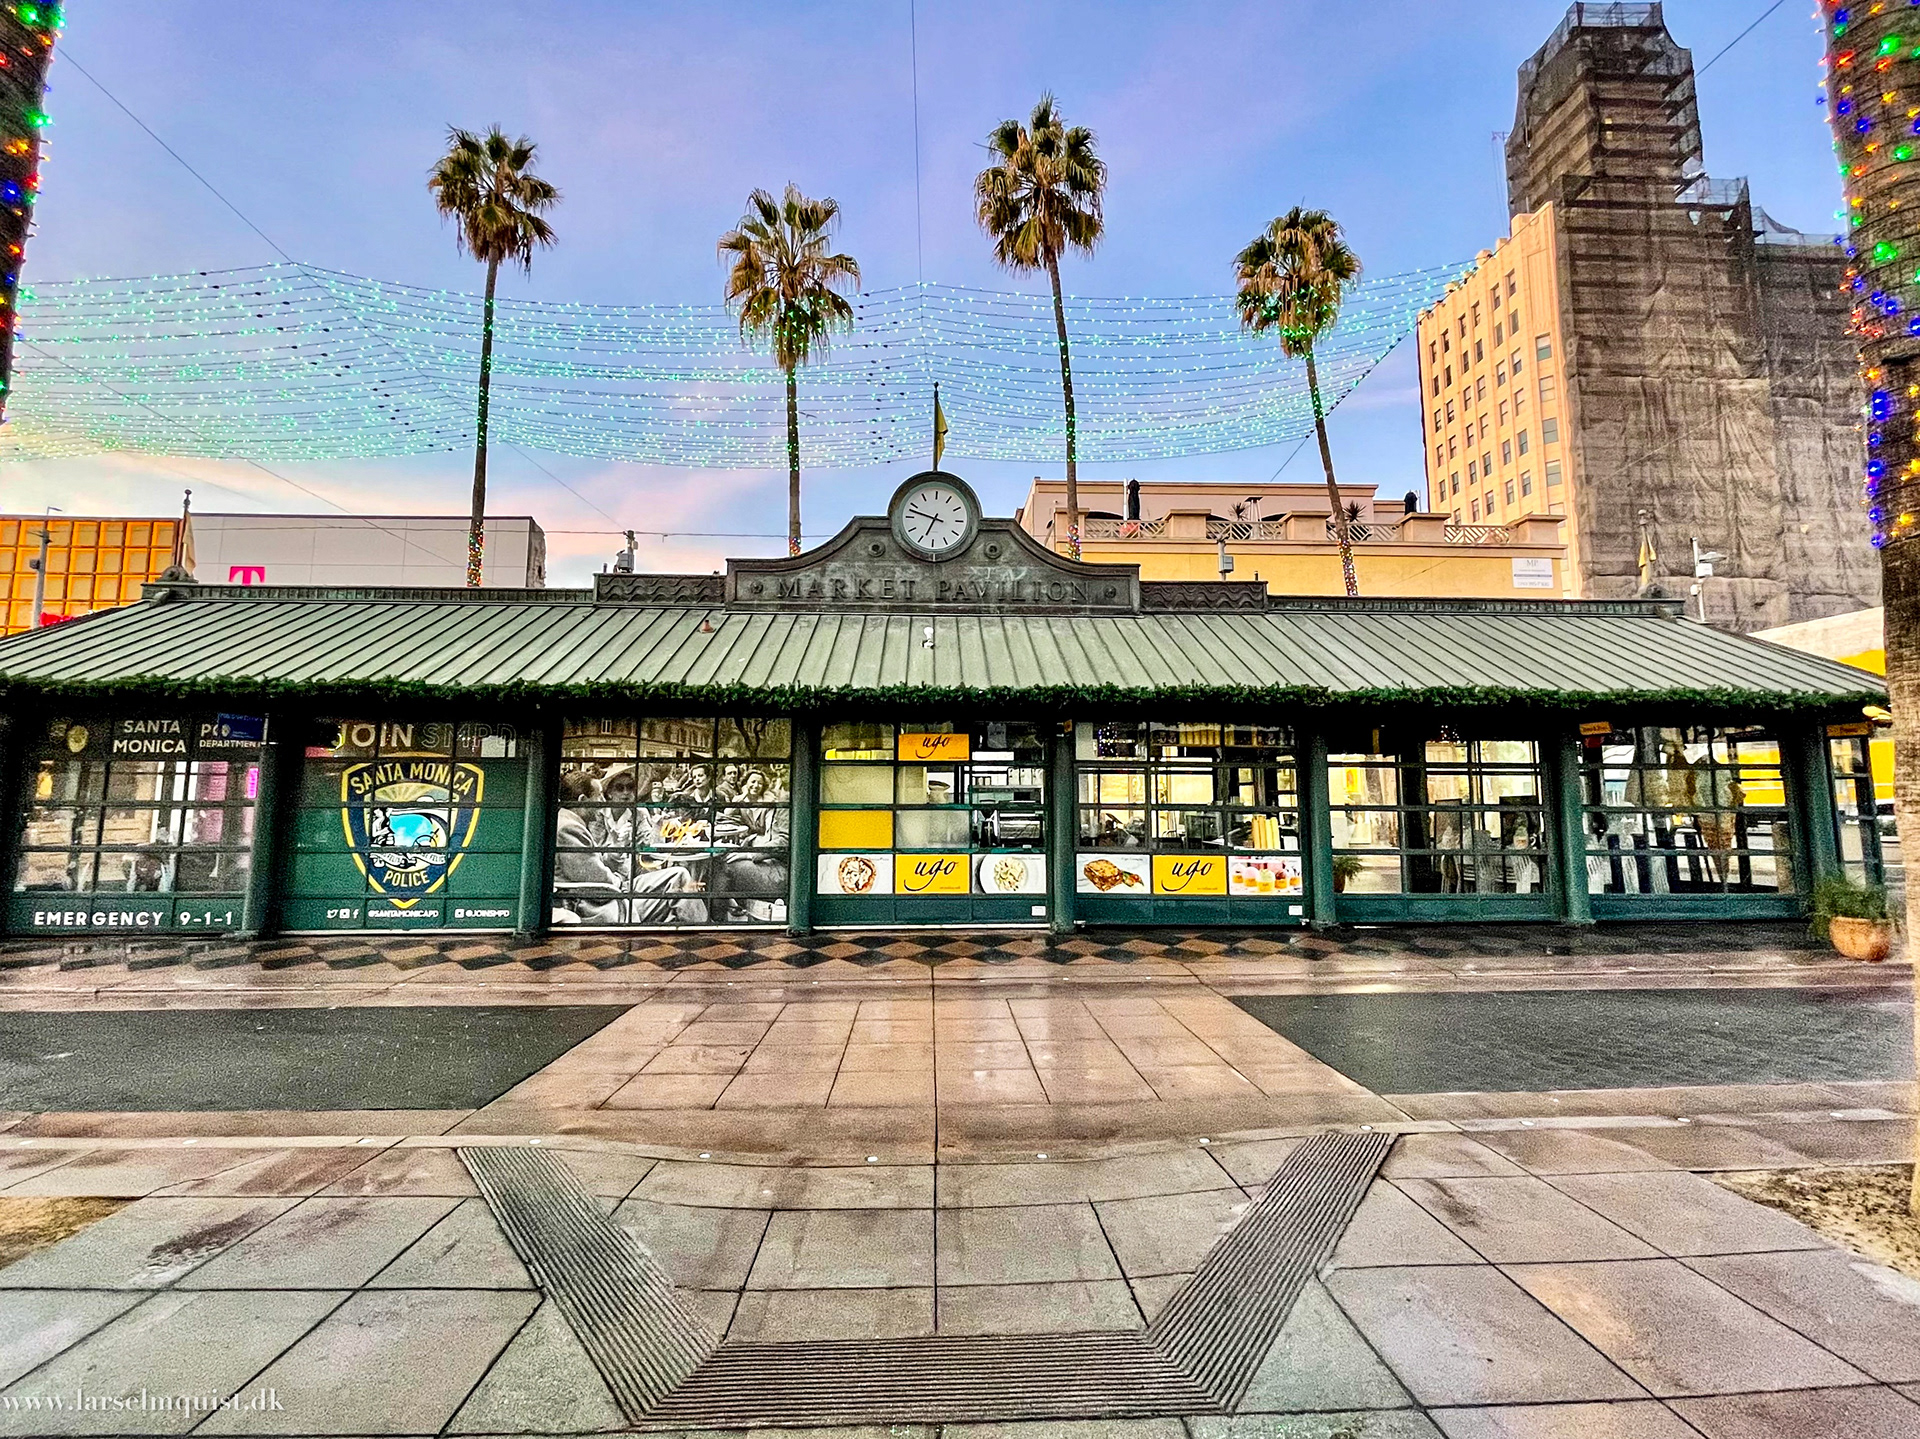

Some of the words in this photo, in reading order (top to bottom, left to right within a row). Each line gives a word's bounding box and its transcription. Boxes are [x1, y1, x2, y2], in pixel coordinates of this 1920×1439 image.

[777, 578, 917, 601] MARKET
[936, 580, 1090, 602] PAVILION
[123, 720, 181, 734] SANTA
[331, 722, 414, 748] JOIN
[112, 739, 187, 753] MONICA
[915, 735, 951, 759] ugo
[350, 763, 404, 794] SANTA
[409, 762, 474, 796] MONICA
[383, 870, 430, 888] POLICE
[903, 858, 959, 892] ugo
[1161, 860, 1214, 892] ugo
[34, 911, 164, 926] EMERGENCY
[179, 911, 233, 926] 9-1-1
